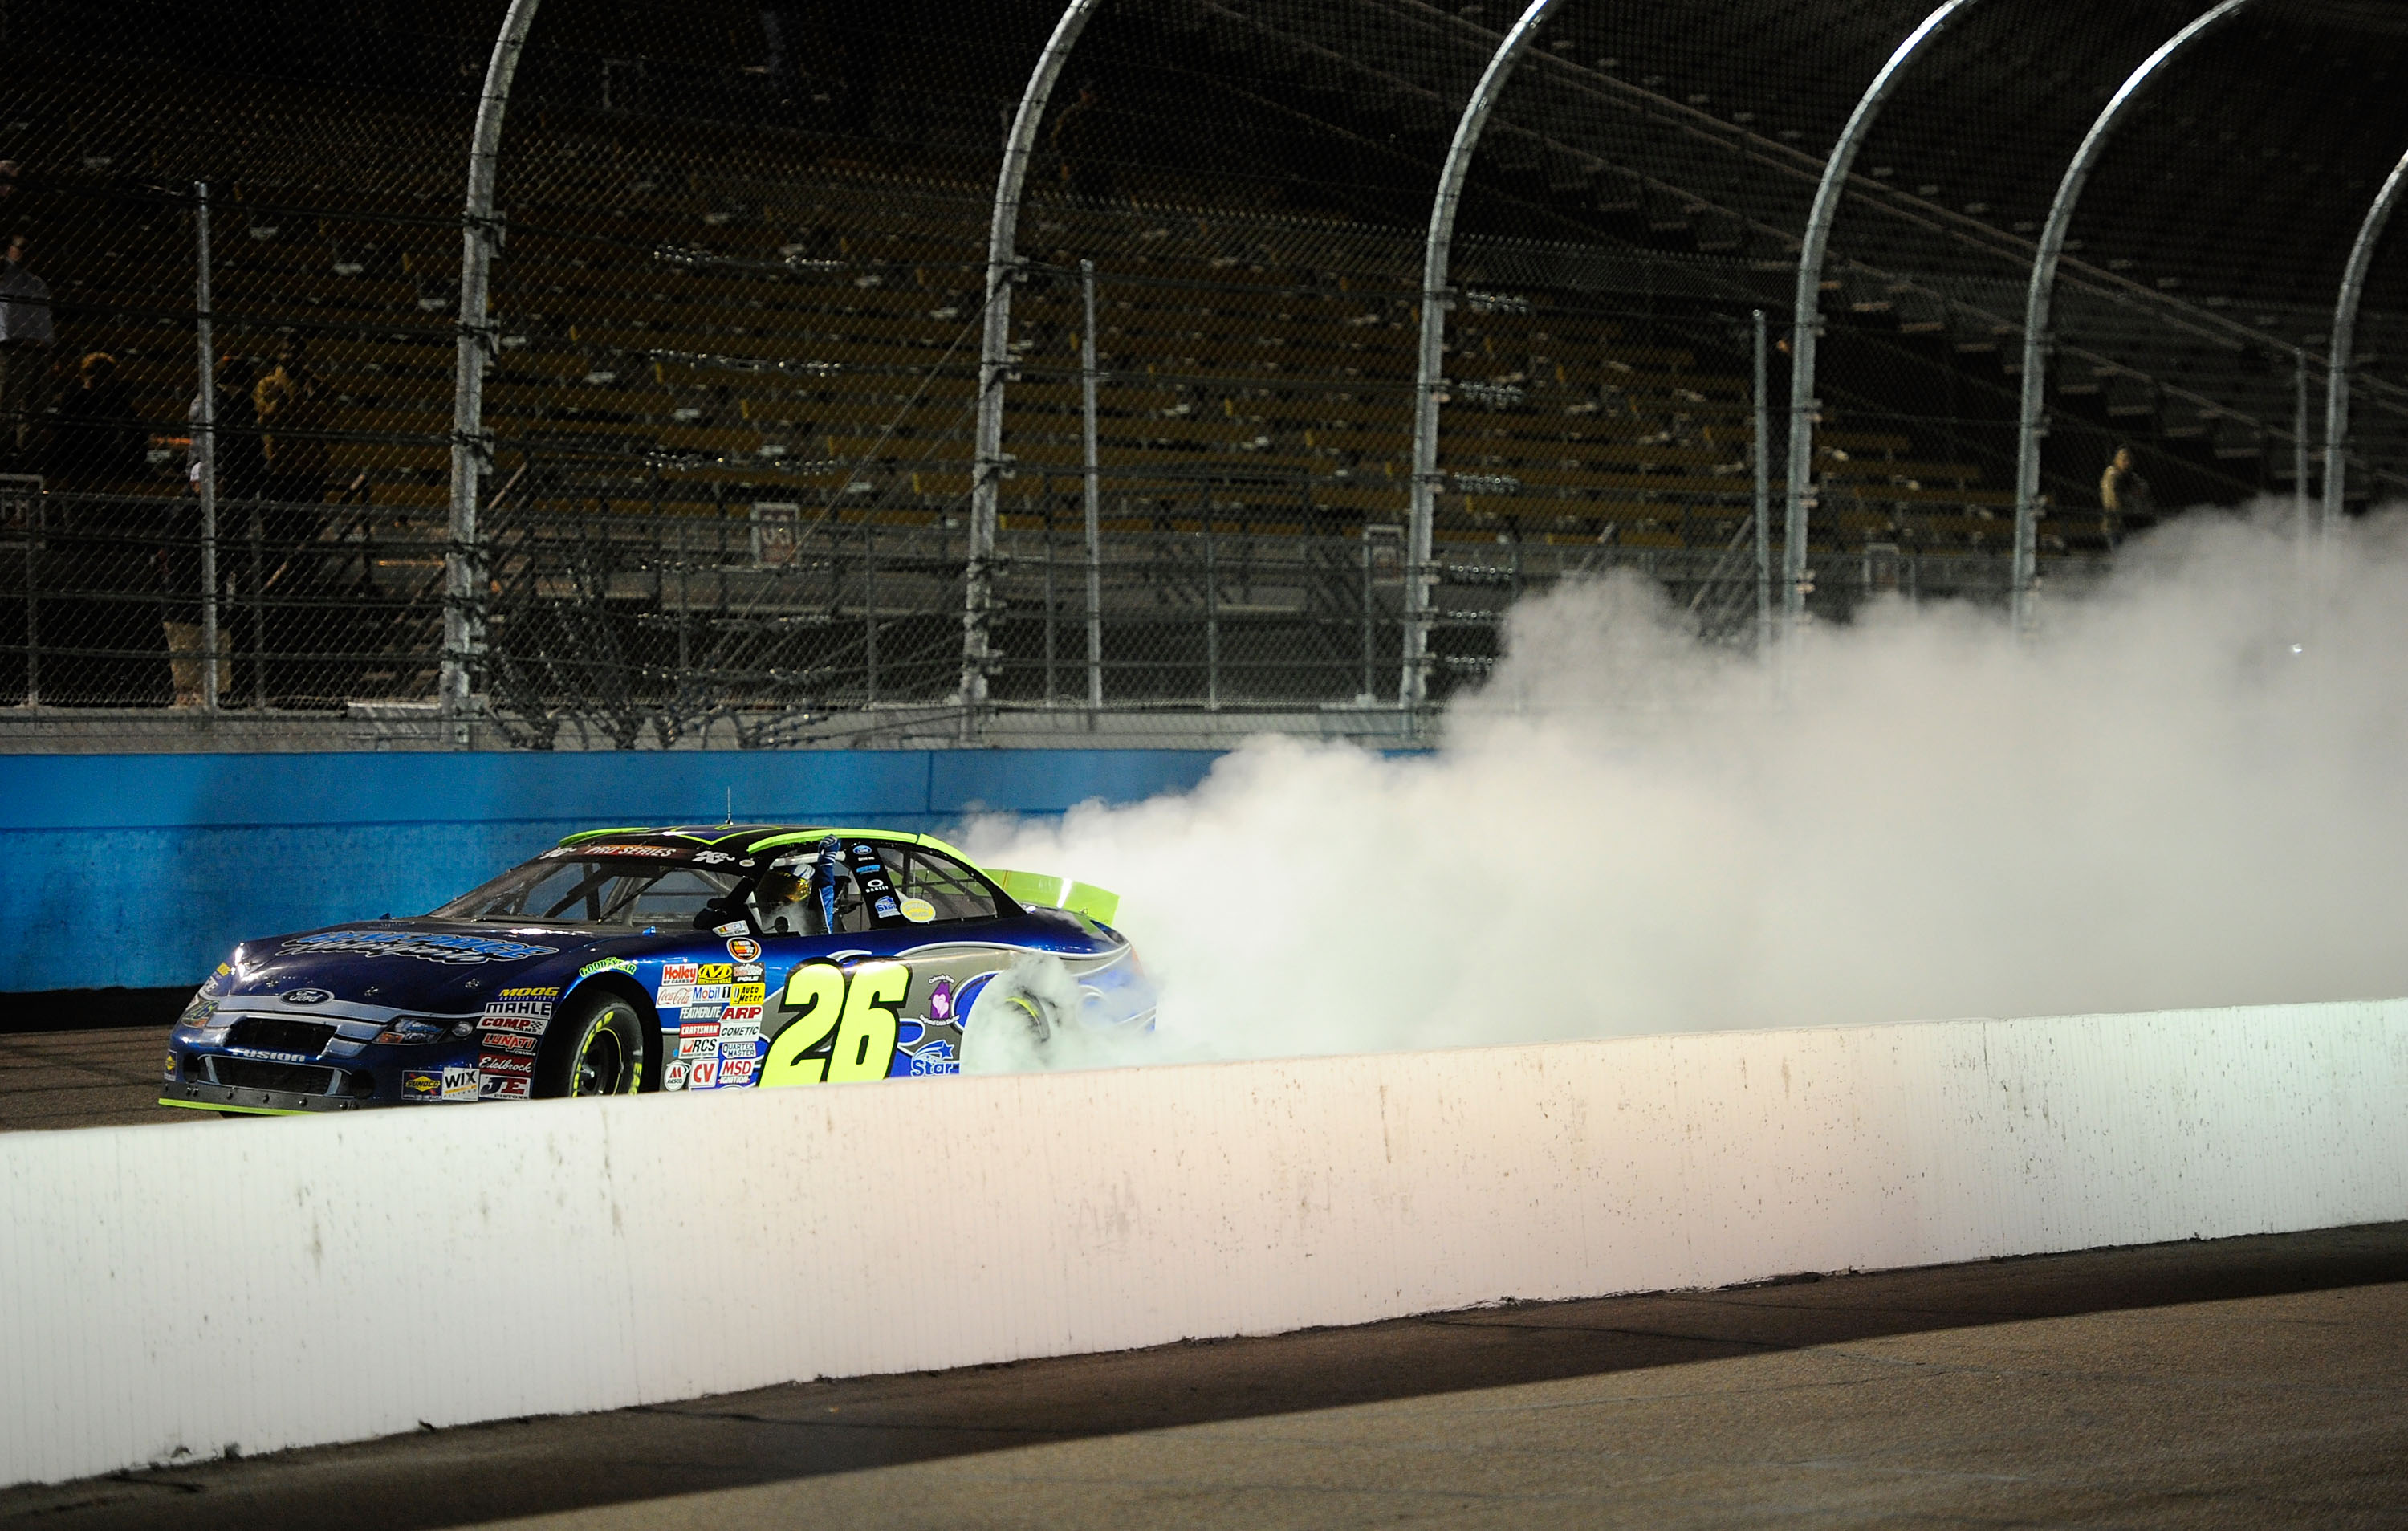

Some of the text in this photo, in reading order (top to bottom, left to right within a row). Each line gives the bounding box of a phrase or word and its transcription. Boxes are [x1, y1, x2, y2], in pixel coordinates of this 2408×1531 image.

[584, 846, 676, 857] PRO SERIES
[579, 957, 637, 978] GOODYEAR
[664, 965, 697, 983] Holley
[498, 987, 560, 996] MOOG
[693, 986, 731, 999] Mobil 1
[486, 1003, 551, 1016] MAHLE
[680, 1006, 722, 1019] FEATHERLITE
[721, 1007, 762, 1020] ARP
[482, 1018, 531, 1028] COMP
[681, 1024, 719, 1035] CRAFTSMAN
[759, 963, 909, 1089] 26
[721, 1027, 759, 1036] COMETIC
[484, 1034, 534, 1049] LUNATI
[692, 1039, 717, 1053] RCS
[723, 1044, 754, 1053] QUARTER
[479, 1057, 533, 1073] Edelbrock
[722, 1061, 752, 1075] MSD
[911, 1059, 952, 1076] Star
[445, 1071, 476, 1088] WIX
[694, 1064, 714, 1083] CV
[480, 1077, 527, 1096] JE
